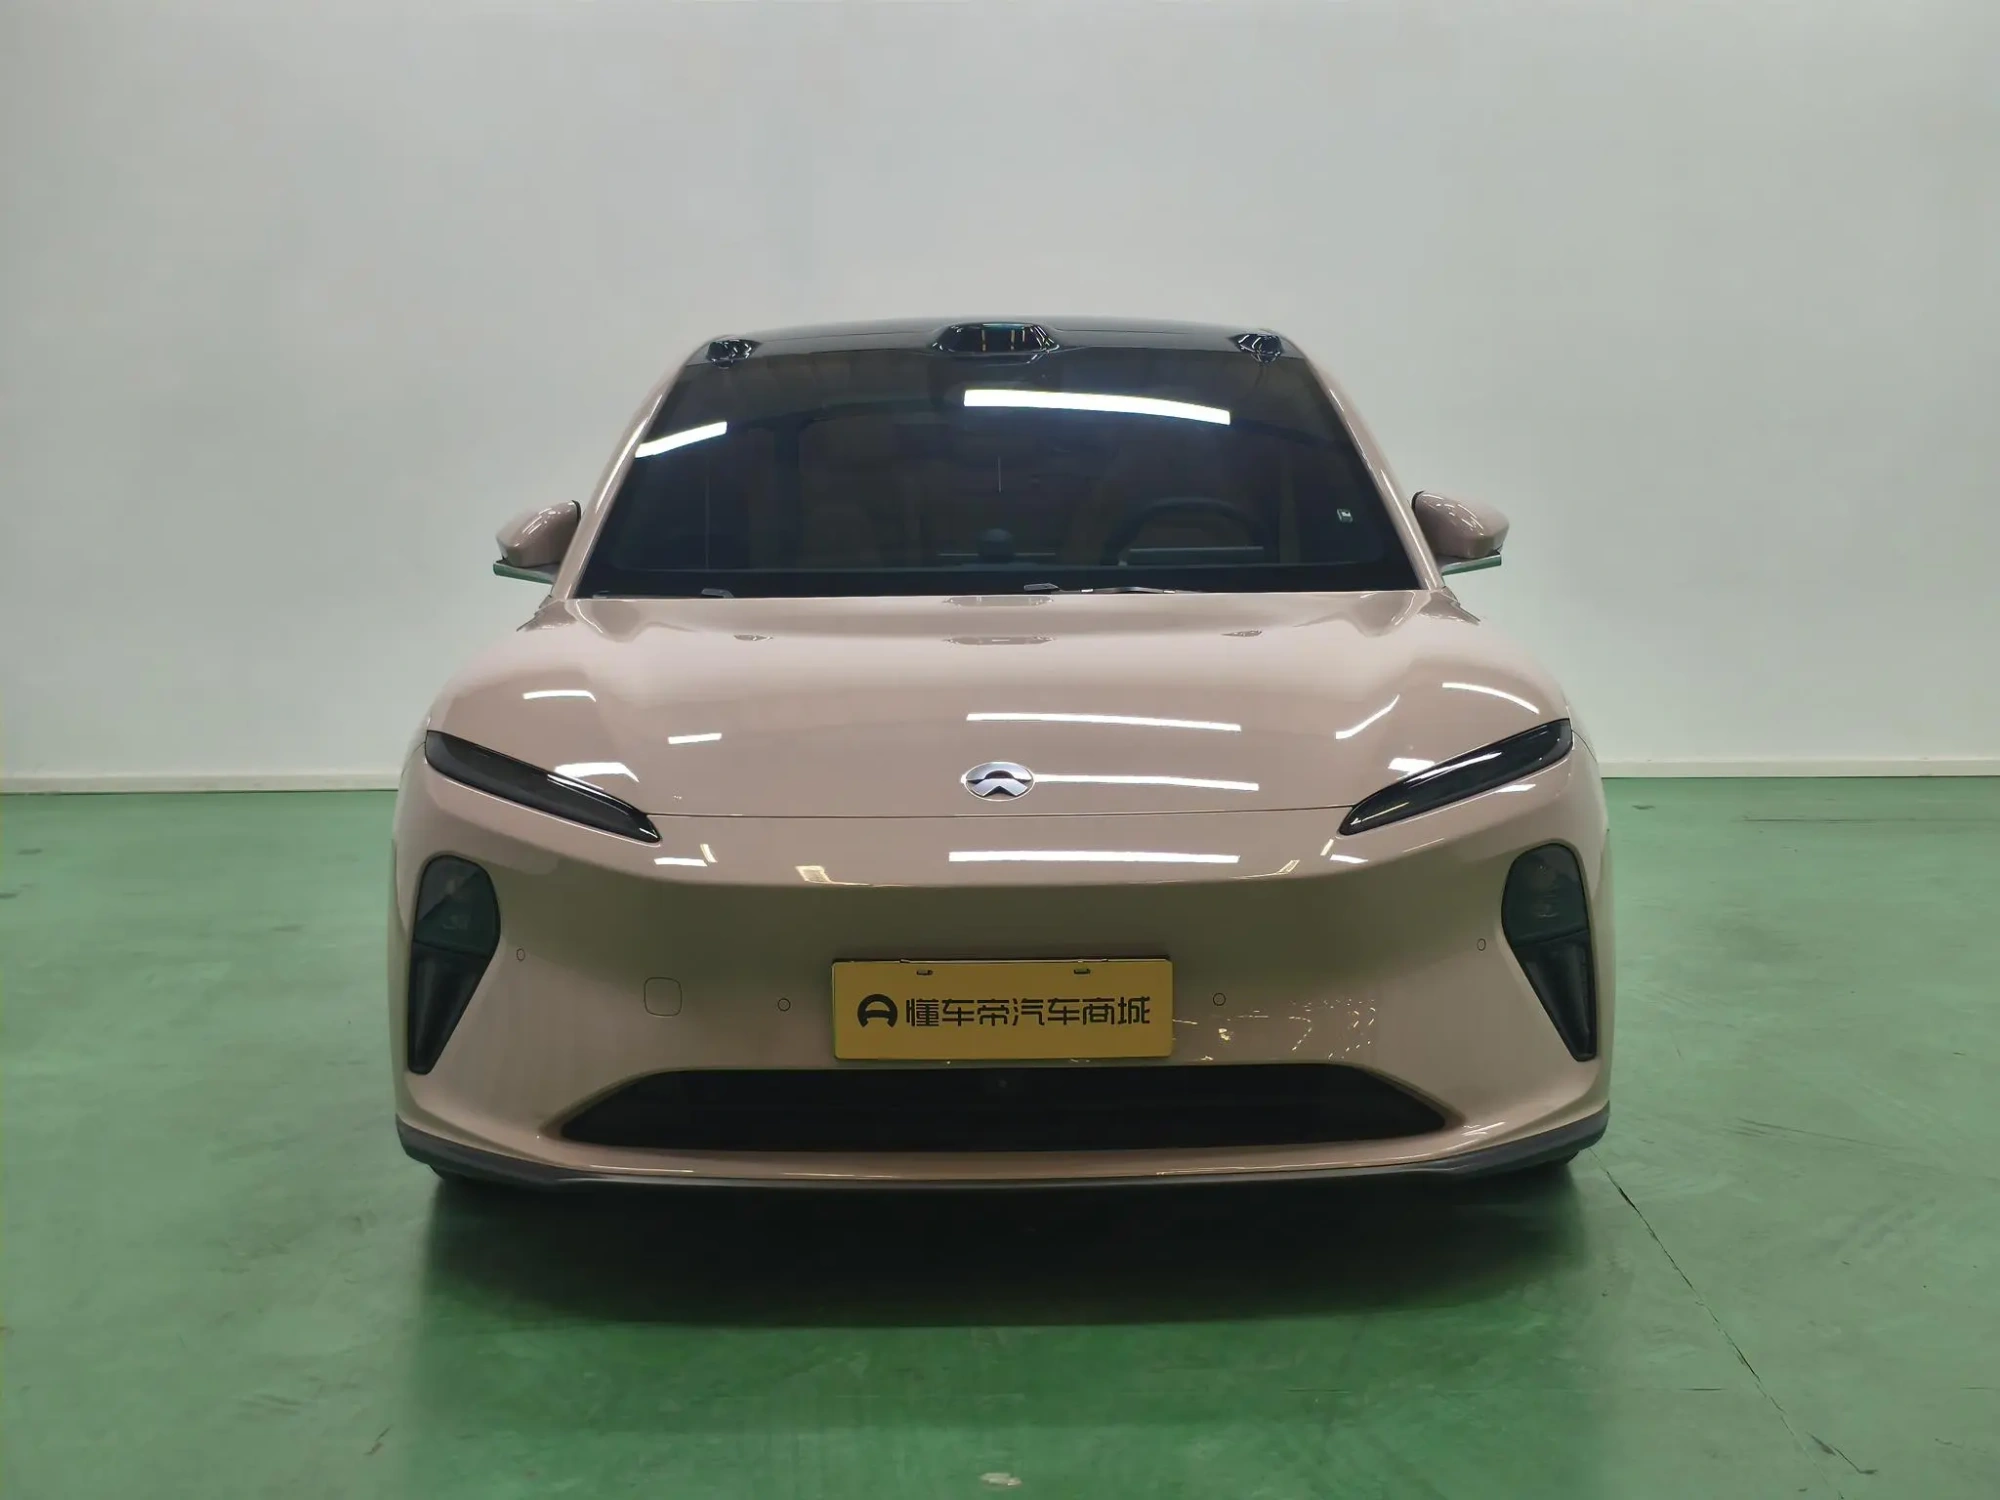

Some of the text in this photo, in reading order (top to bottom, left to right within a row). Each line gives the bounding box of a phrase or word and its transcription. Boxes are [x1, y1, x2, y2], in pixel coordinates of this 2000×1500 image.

[905, 996, 1150, 1027] 懂车帝汽车商城
